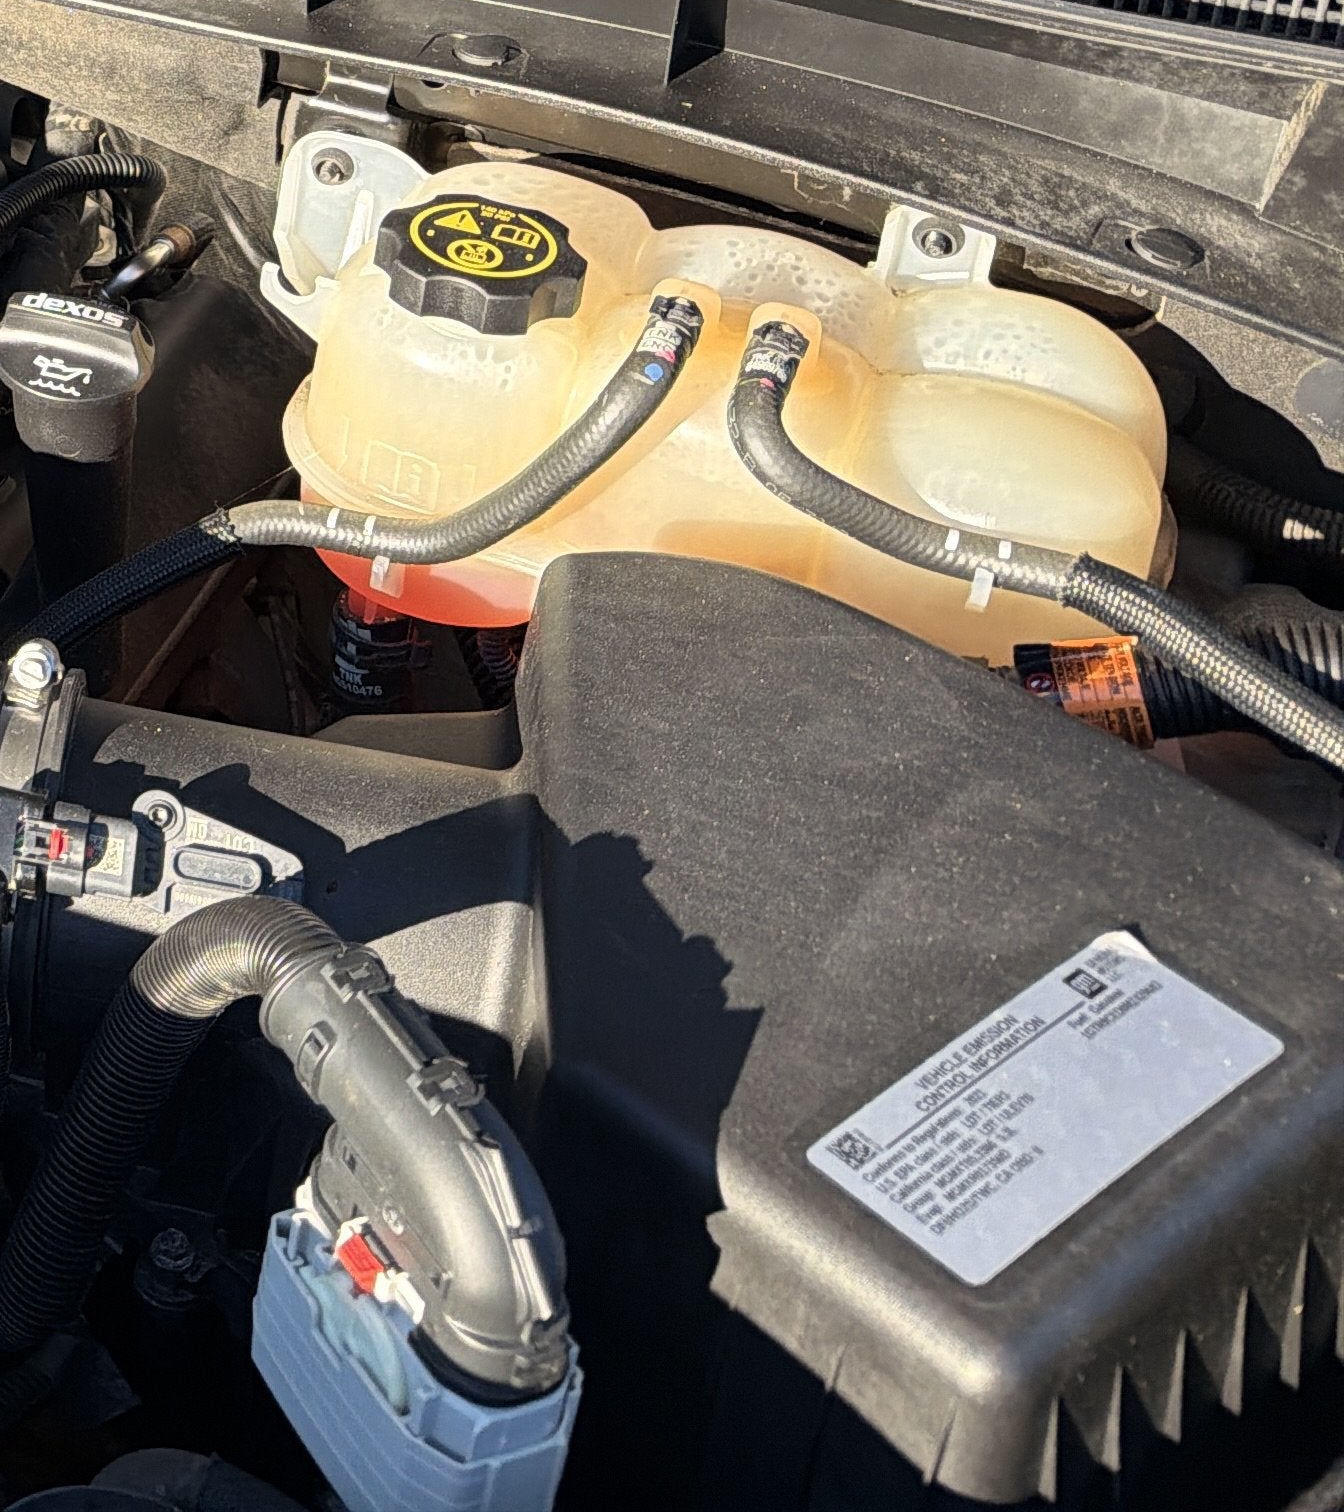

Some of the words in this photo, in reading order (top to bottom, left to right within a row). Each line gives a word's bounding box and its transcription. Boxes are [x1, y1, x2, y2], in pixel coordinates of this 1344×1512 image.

[22, 292, 124, 328] dexos
[339, 668, 362, 686] TNK
[912, 1050, 970, 1092] VEHICLE
[959, 1012, 1021, 1058] EMISSION
[912, 1066, 976, 1114] CONTROL
[965, 1014, 1048, 1075] INFORMATION
[859, 1147, 908, 1184] Conforms
[899, 1140, 917, 1153] to
[886, 1167, 935, 1205] California
